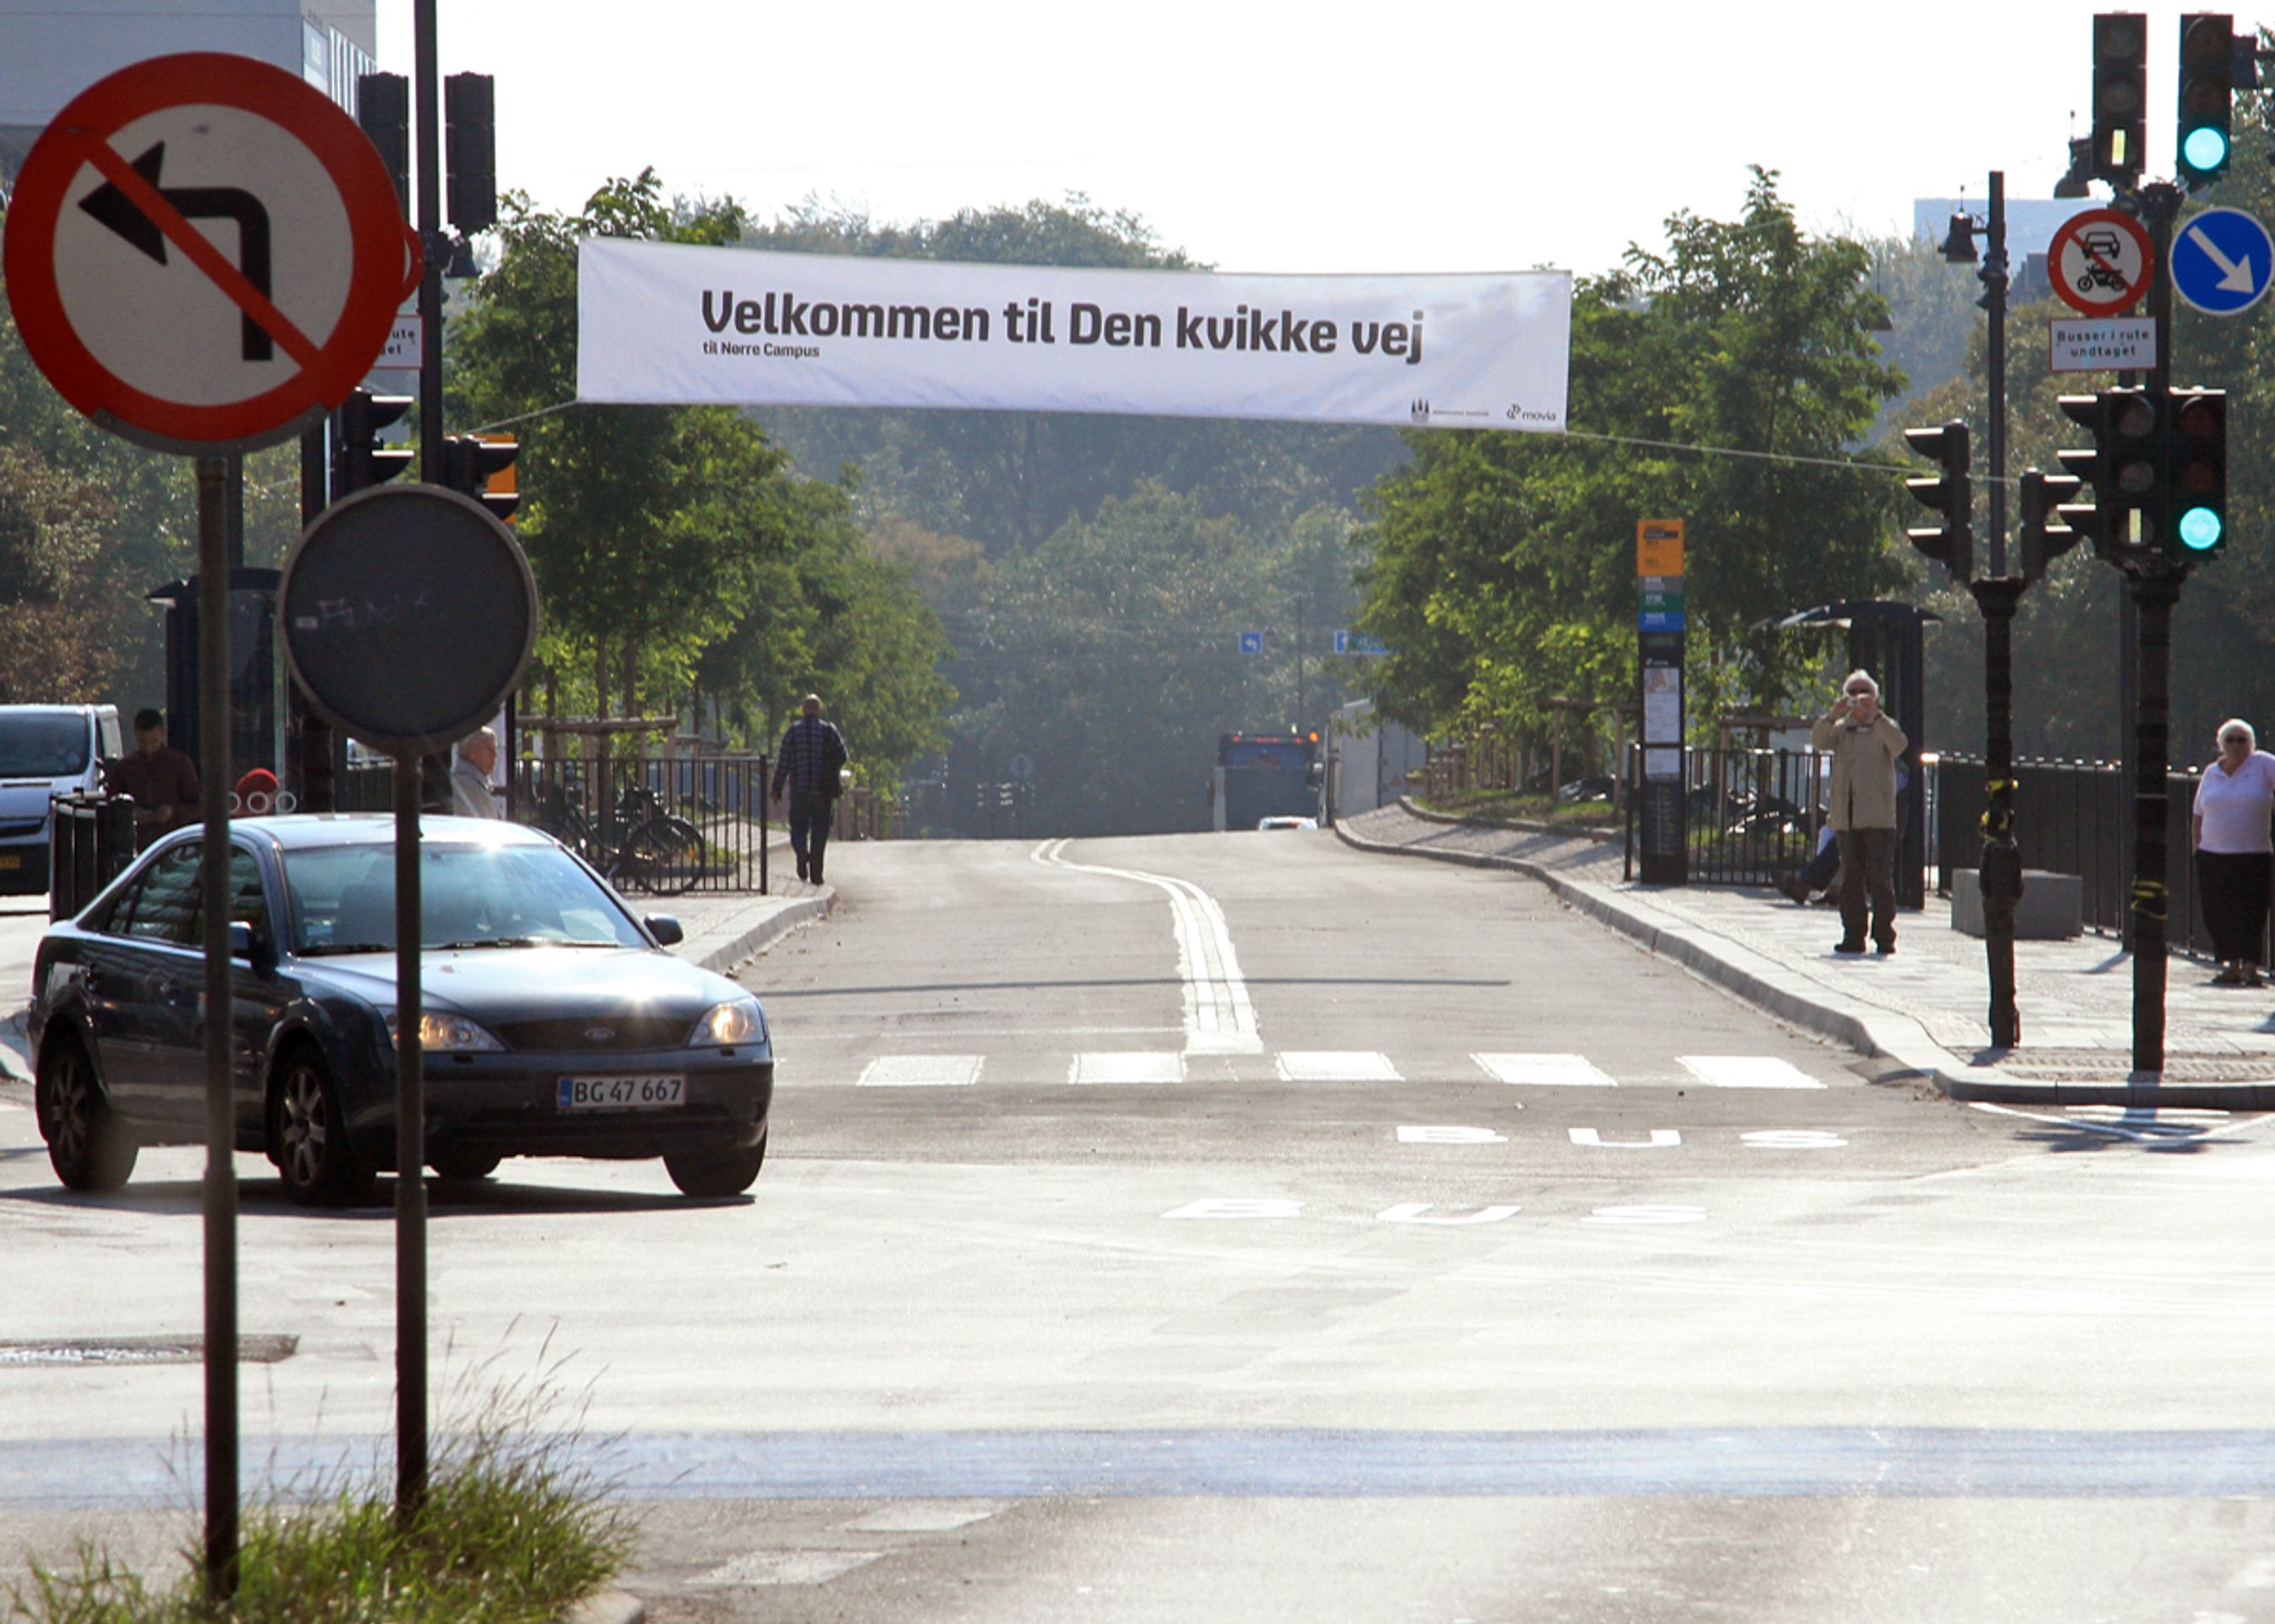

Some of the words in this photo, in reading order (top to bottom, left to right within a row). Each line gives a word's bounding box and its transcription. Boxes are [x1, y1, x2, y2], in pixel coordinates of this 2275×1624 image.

[701, 289, 990, 341] Velkommen
[1002, 297, 1056, 344] til
[1069, 303, 1161, 348] Den
[1176, 305, 1337, 353] kvikke
[1351, 310, 1424, 365] vej
[2057, 330, 2105, 342] Busser
[2120, 329, 2148, 339] rute
[703, 340, 718, 354] til
[763, 342, 820, 359] Campus
[2071, 345, 2136, 358] undtaget
[1521, 410, 1557, 421] movia
[575, 1082, 604, 1103] BG
[609, 1081, 635, 1102] 47
[641, 1080, 681, 1101] 667
[1397, 1125, 1850, 1149] BUS
